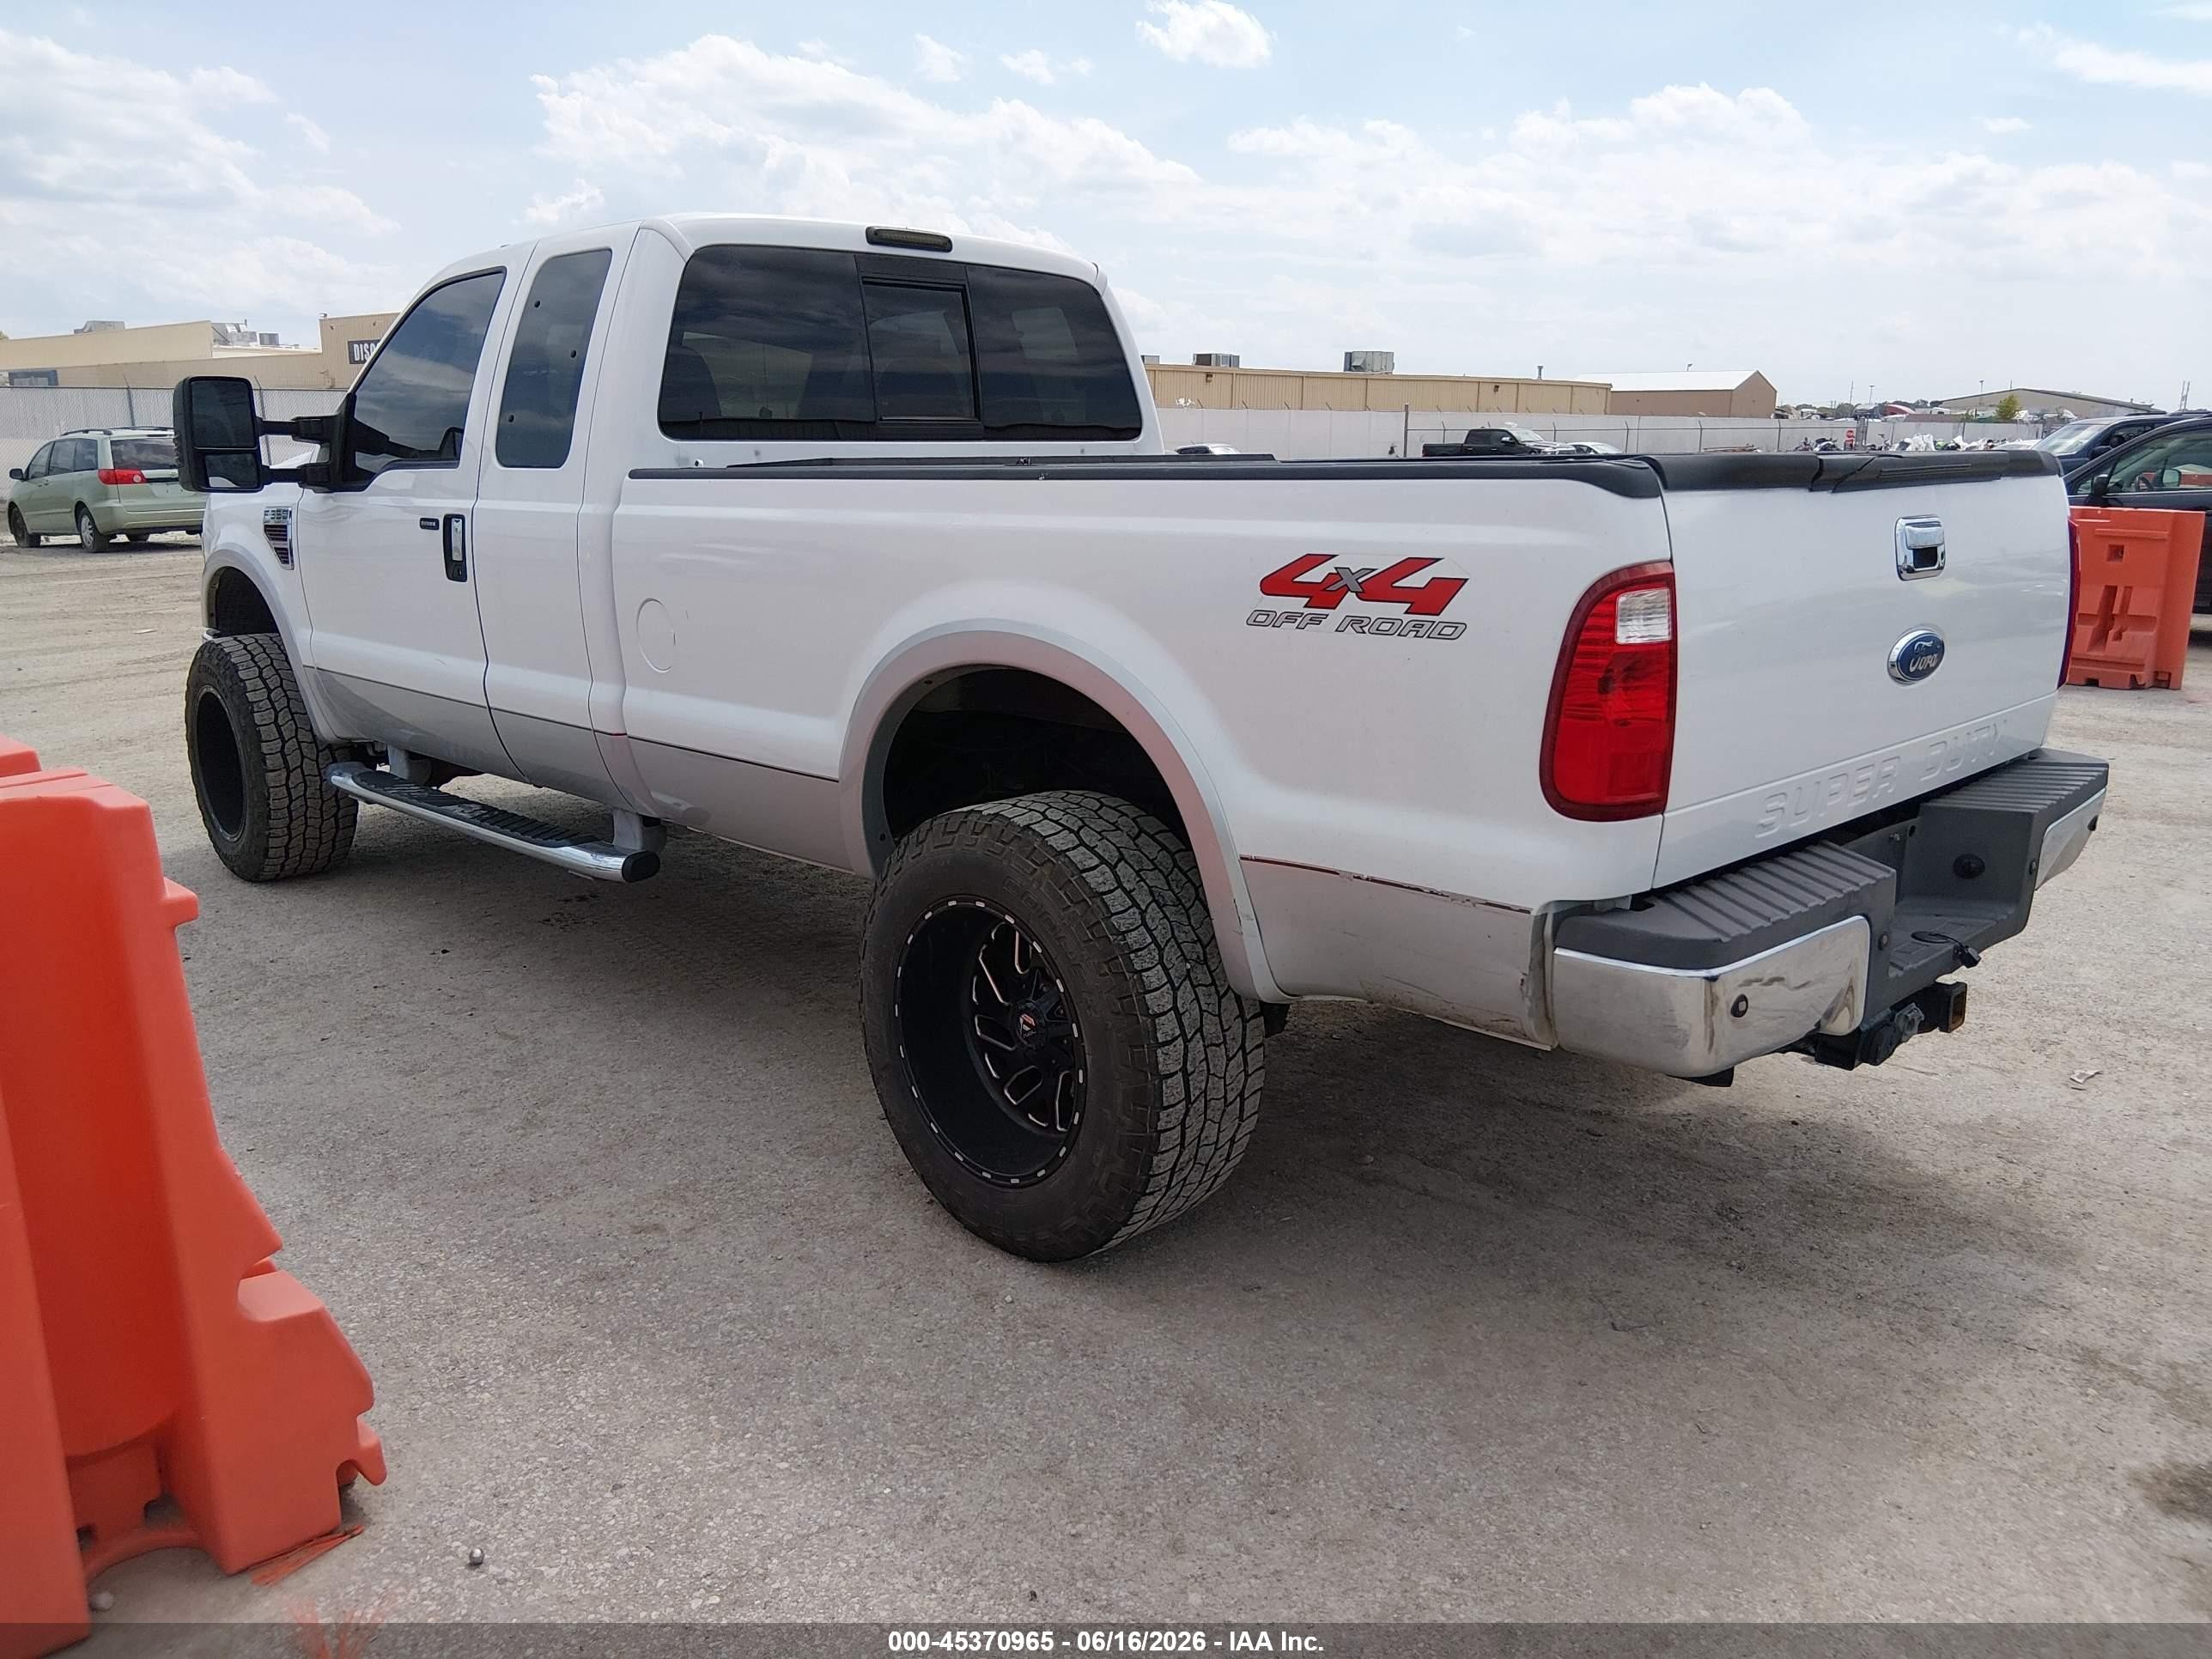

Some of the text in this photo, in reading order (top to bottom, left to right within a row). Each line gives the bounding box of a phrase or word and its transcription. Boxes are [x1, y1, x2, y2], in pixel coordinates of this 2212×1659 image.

[1246, 610, 1468, 641] OFF ROAD
[1909, 641, 1939, 673] Ford
[1754, 755, 1902, 839] SUPER
